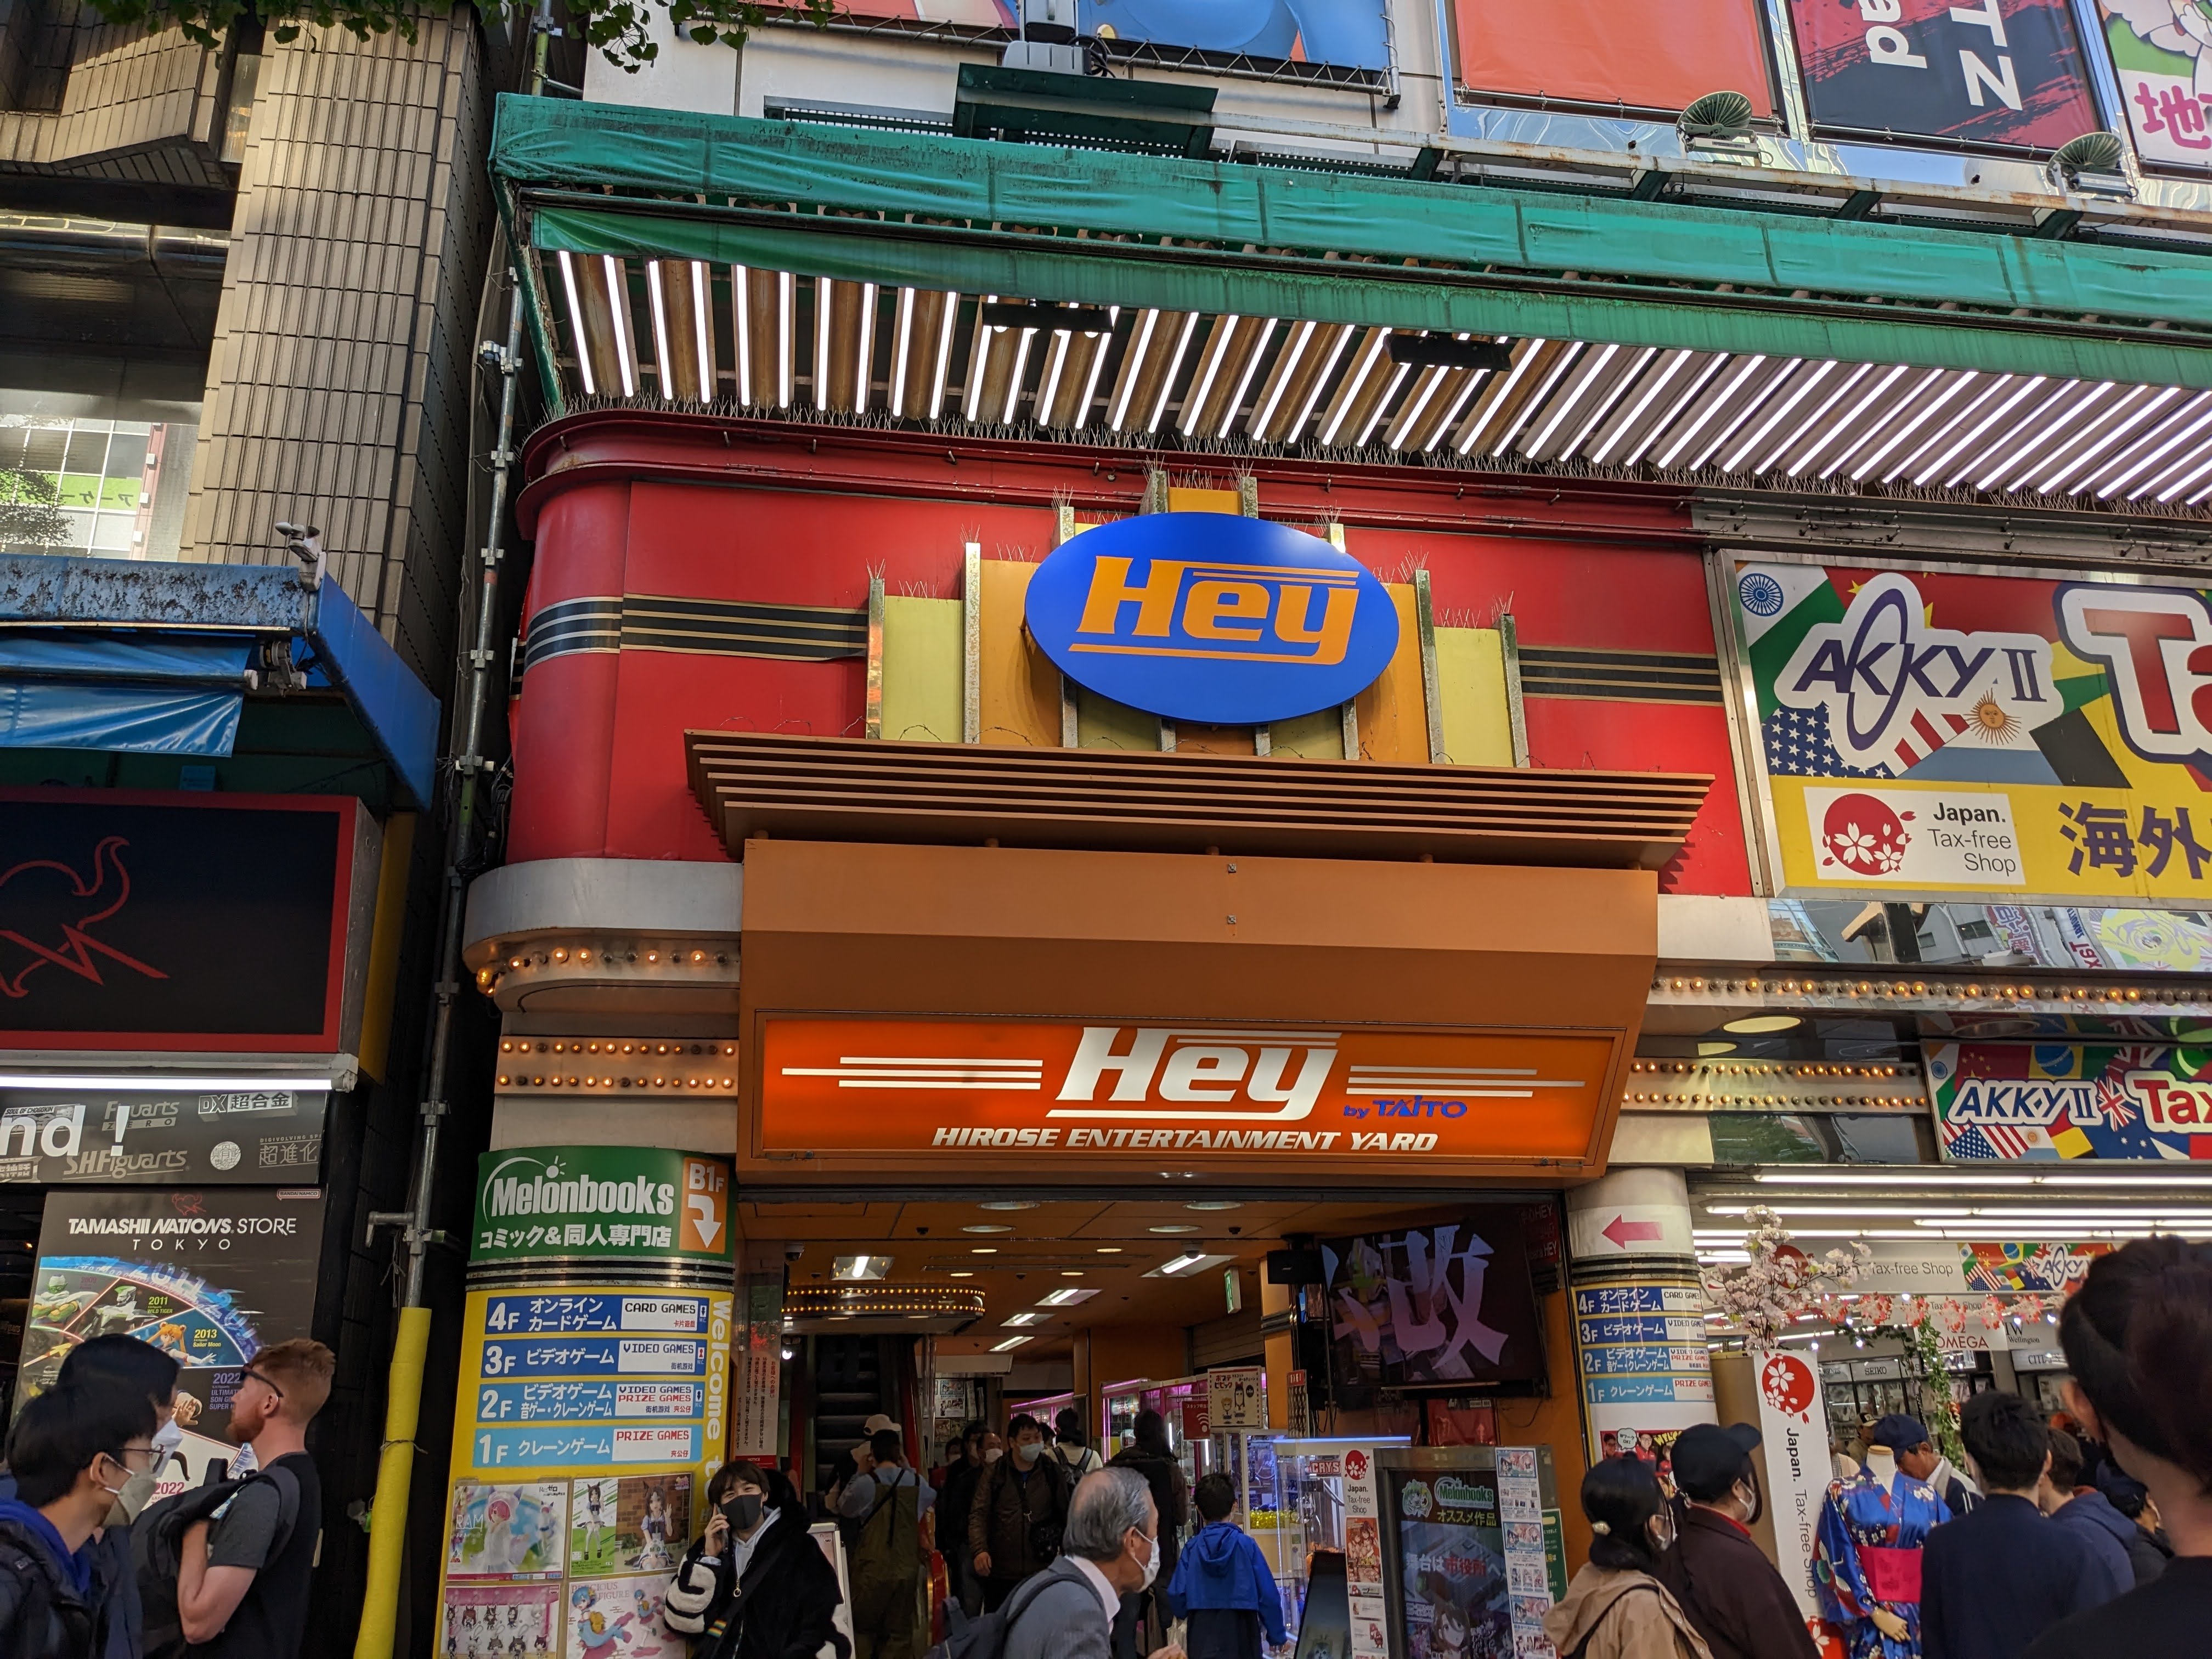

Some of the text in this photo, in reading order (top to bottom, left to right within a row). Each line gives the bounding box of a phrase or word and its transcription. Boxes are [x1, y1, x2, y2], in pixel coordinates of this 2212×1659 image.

[2134, 82, 2212, 150] 地
[1068, 556, 1360, 665] Hey
[1933, 802, 2006, 826] Japan.
[1927, 828, 2012, 851] Tax-free
[2058, 802, 2212, 880] 海外
[1964, 853, 2017, 875] Shop
[1046, 1026, 1343, 1121] Hey
[230, 1092, 290, 1109] 超合金
[1344, 1094, 1468, 1119] by TAITO
[27, 1106, 54, 1114] CHOGOKIN
[932, 1127, 1439, 1152] HIROSE ENTERTAINMENT YARD
[259, 1142, 318, 1165] 超進化
[491, 1163, 725, 1217] Melonbooks B1F
[69, 1218, 151, 1234] TAMASHII
[237, 1218, 297, 1235] STORE
[479, 1224, 672, 1249] コミック&同人専門店
[1922, 1261, 1954, 1278] Shop
[148, 1296, 168, 1305] 2011
[1578, 1293, 1595, 1313] 4F
[1599, 1289, 1650, 1301] オンライン
[1685, 1291, 1701, 1300] GAMES
[529, 1297, 603, 1314] オンライン
[625, 1302, 696, 1314] CARD GAMES
[1600, 1301, 1662, 1313] カードゲーム
[488, 1302, 520, 1331] 4F
[528, 1315, 617, 1332] カードゲーム
[194, 1329, 217, 1339] 2013
[1581, 1323, 1598, 1343] 3F
[1603, 1323, 1664, 1336] ビデオゲーム
[1936, 1336, 1989, 1348] OMEGA
[2008, 1335, 2040, 1344] Wellington
[526, 1346, 615, 1365] ビデオゲーム
[623, 1343, 694, 1354] VIDEO GAMES
[1606, 1347, 1667, 1360] ビデオゲーム
[485, 1346, 515, 1374] 3F
[1584, 1352, 1601, 1372] 2F
[213, 1373, 241, 1384] 2022
[707, 1300, 731, 1441] Welcome
[1864, 1365, 1888, 1375] SEIKO
[523, 1384, 612, 1400] ビデオゲーム
[1588, 1382, 1605, 1402] 1F
[1610, 1384, 1673, 1397] クレーンゲーム
[482, 1390, 512, 1418] 2F
[616, 1430, 690, 1441] PRIZE GAMES
[479, 1435, 509, 1463] 1F
[518, 1437, 610, 1456] クレーンゲーム
[1438, 1485, 1493, 1502] Melonbooks
[1786, 1427, 1802, 1482] Japan.
[1795, 1489, 1812, 1553] Tax-free
[1347, 1495, 1370, 1504] Tax-free
[1352, 1505, 1367, 1515] Shop
